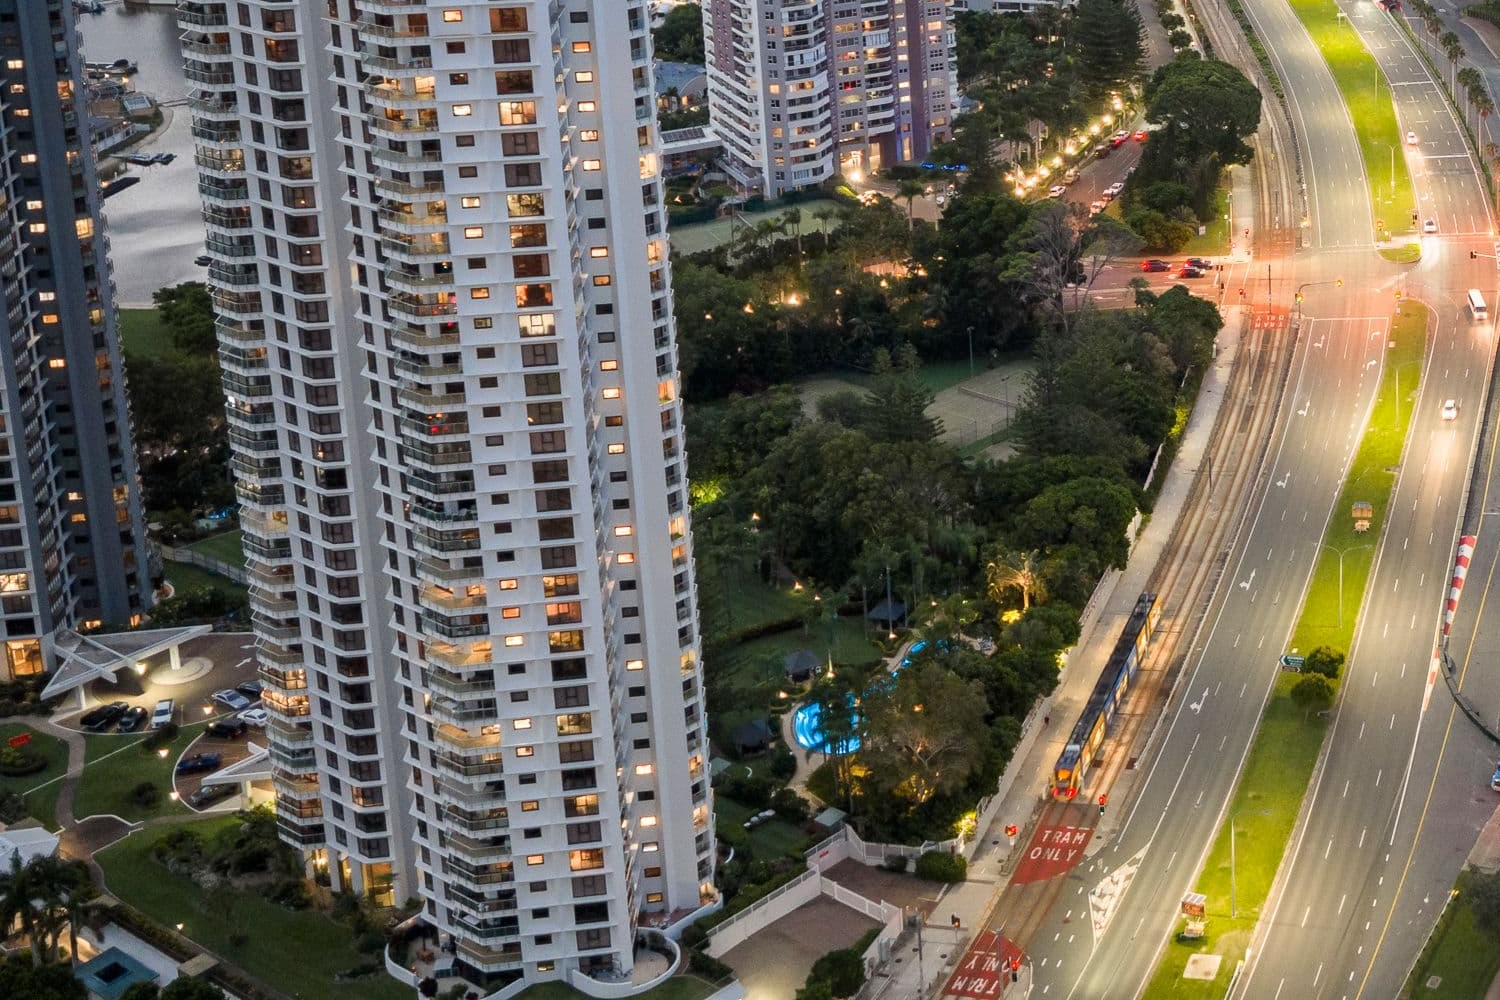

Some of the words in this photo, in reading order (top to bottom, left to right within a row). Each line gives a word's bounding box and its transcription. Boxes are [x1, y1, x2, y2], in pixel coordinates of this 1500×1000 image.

[1041, 830, 1087, 845] TRAM
[1030, 846, 1078, 862] ONLY
[951, 975, 999, 996] TRAM
